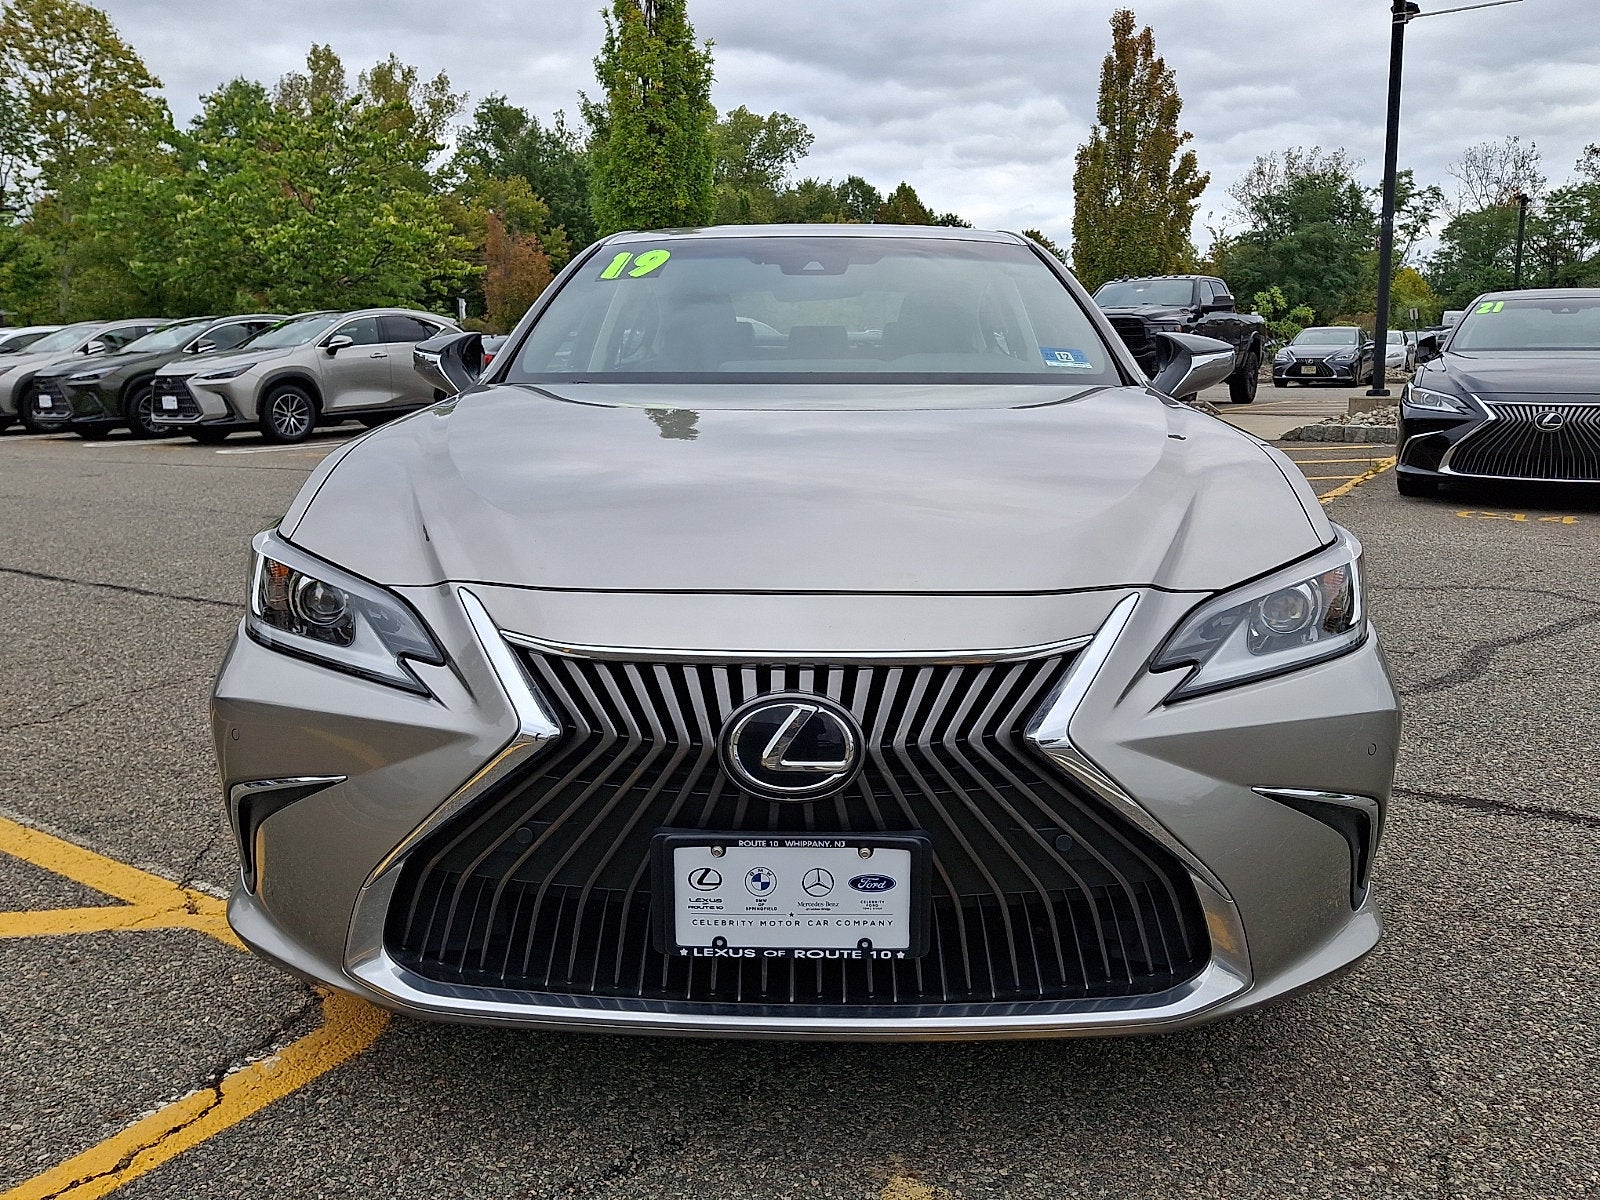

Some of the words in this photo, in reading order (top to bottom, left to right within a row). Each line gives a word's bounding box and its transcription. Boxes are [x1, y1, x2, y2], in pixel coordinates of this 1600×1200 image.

[600, 249, 671, 279] 19
[1475, 301, 1504, 315] 21
[1057, 352, 1071, 360] 12
[834, 840, 845, 848] NJ
[858, 877, 886, 889] Ford
[693, 948, 756, 957] LEXUS
[794, 950, 862, 959] ROUTE
[870, 951, 892, 959] 10
